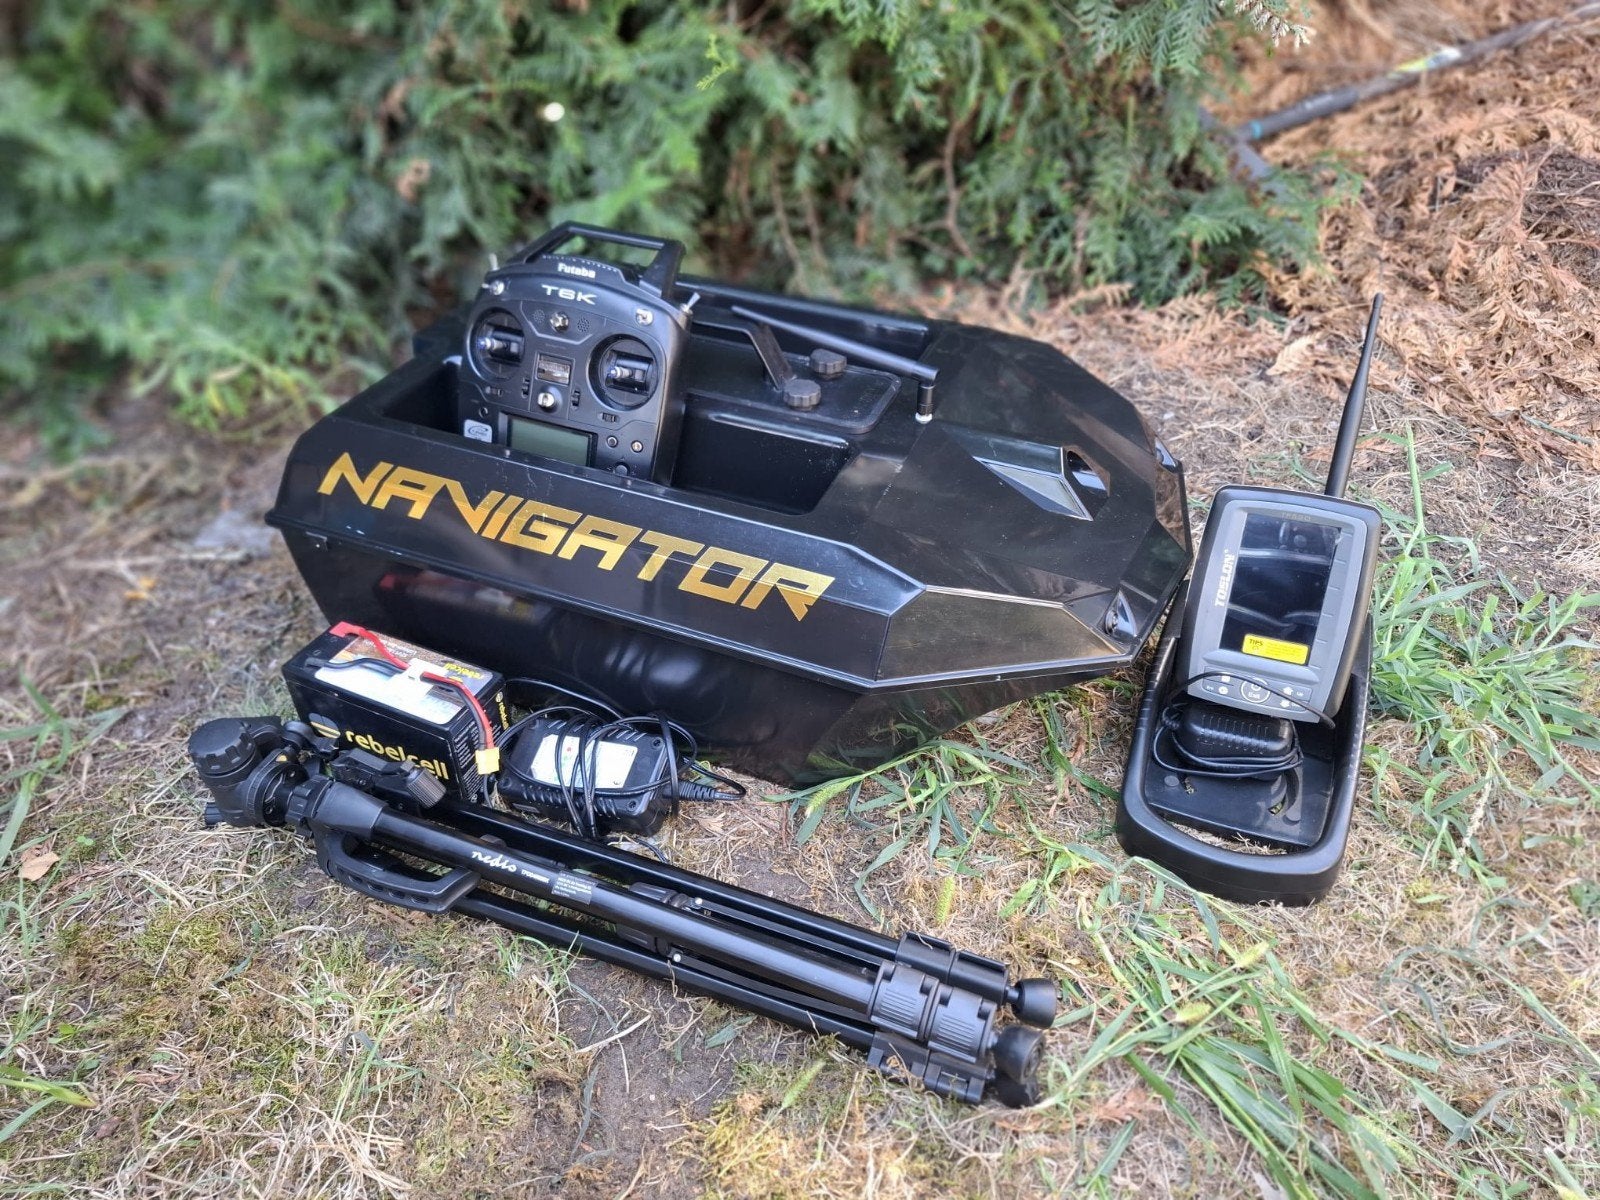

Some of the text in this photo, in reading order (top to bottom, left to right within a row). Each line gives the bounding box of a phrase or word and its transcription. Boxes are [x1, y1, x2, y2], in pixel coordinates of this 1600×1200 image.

[557, 263, 596, 278] Futaba
[541, 284, 597, 305] T6K
[318, 452, 835, 622] NAVIGATOR
[1215, 553, 1235, 607] TOSLON
